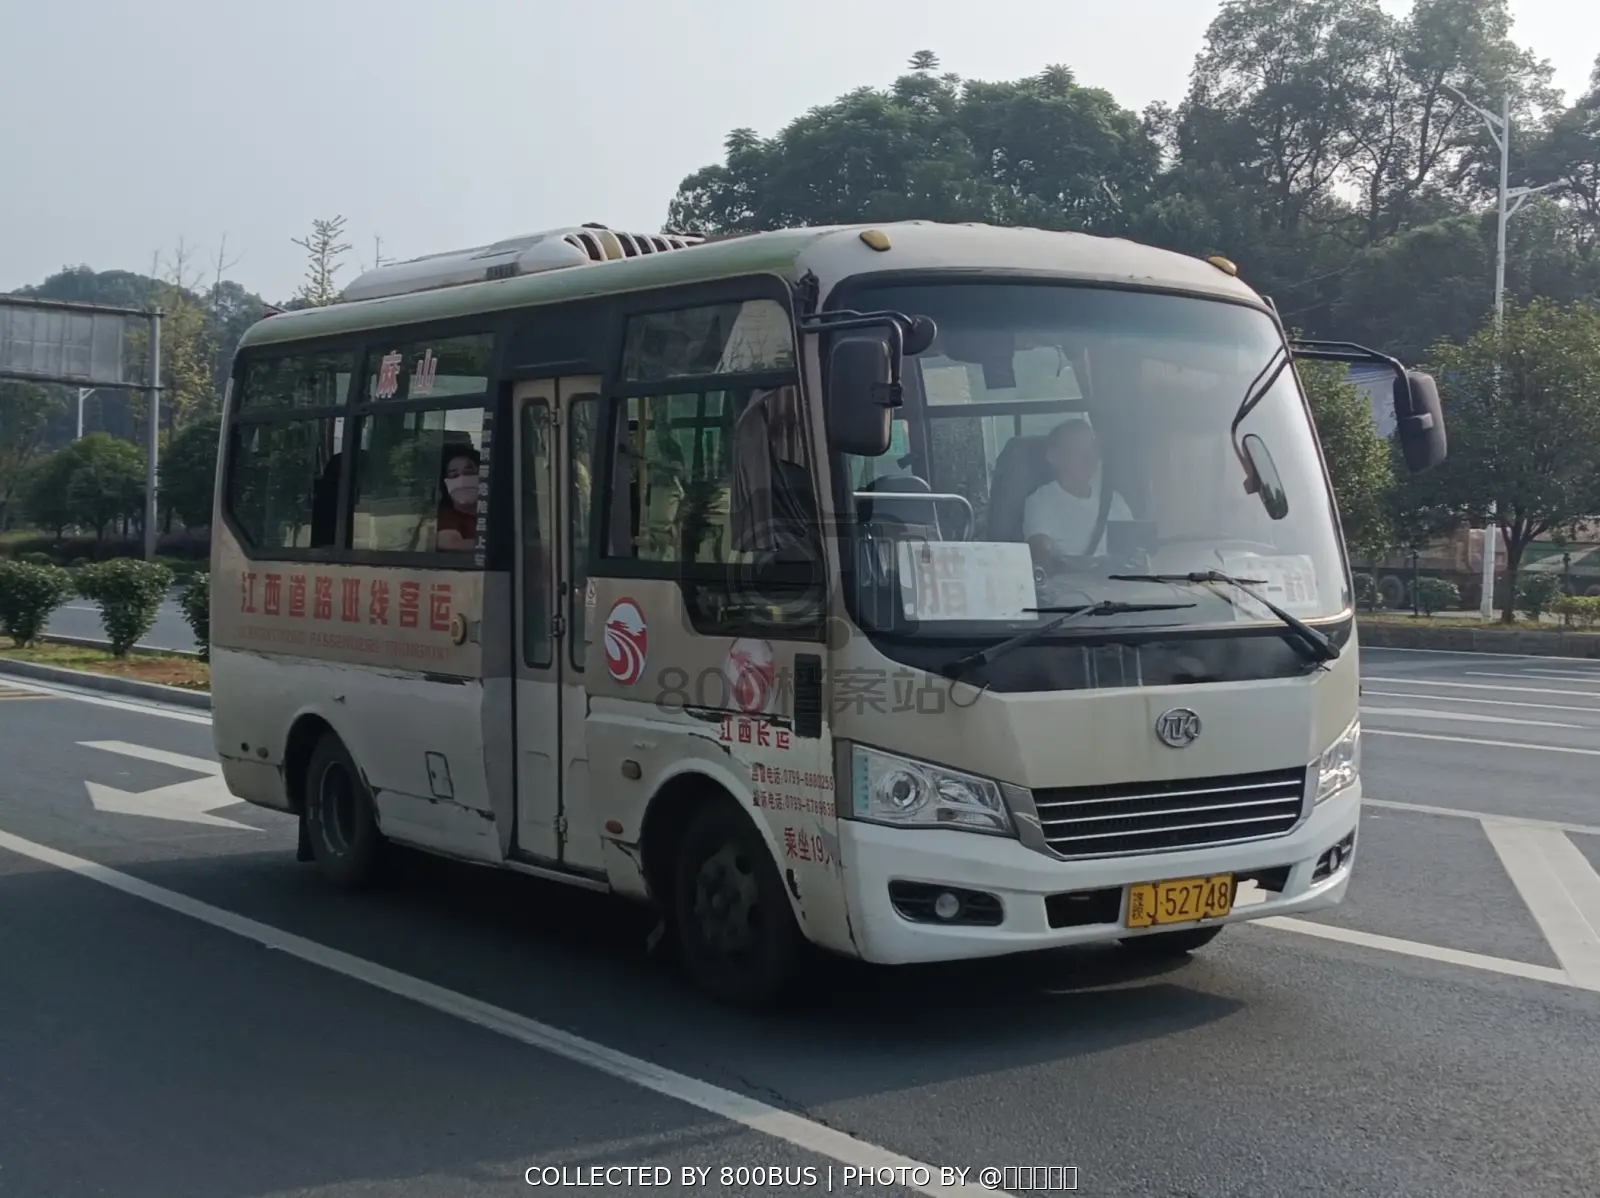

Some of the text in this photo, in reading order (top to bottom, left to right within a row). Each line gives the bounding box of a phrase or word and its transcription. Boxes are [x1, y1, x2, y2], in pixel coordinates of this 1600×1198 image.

[376, 348, 438, 399] 麻山
[241, 571, 453, 632] 江西道路班线客运
[719, 713, 790, 751] 江西长运
